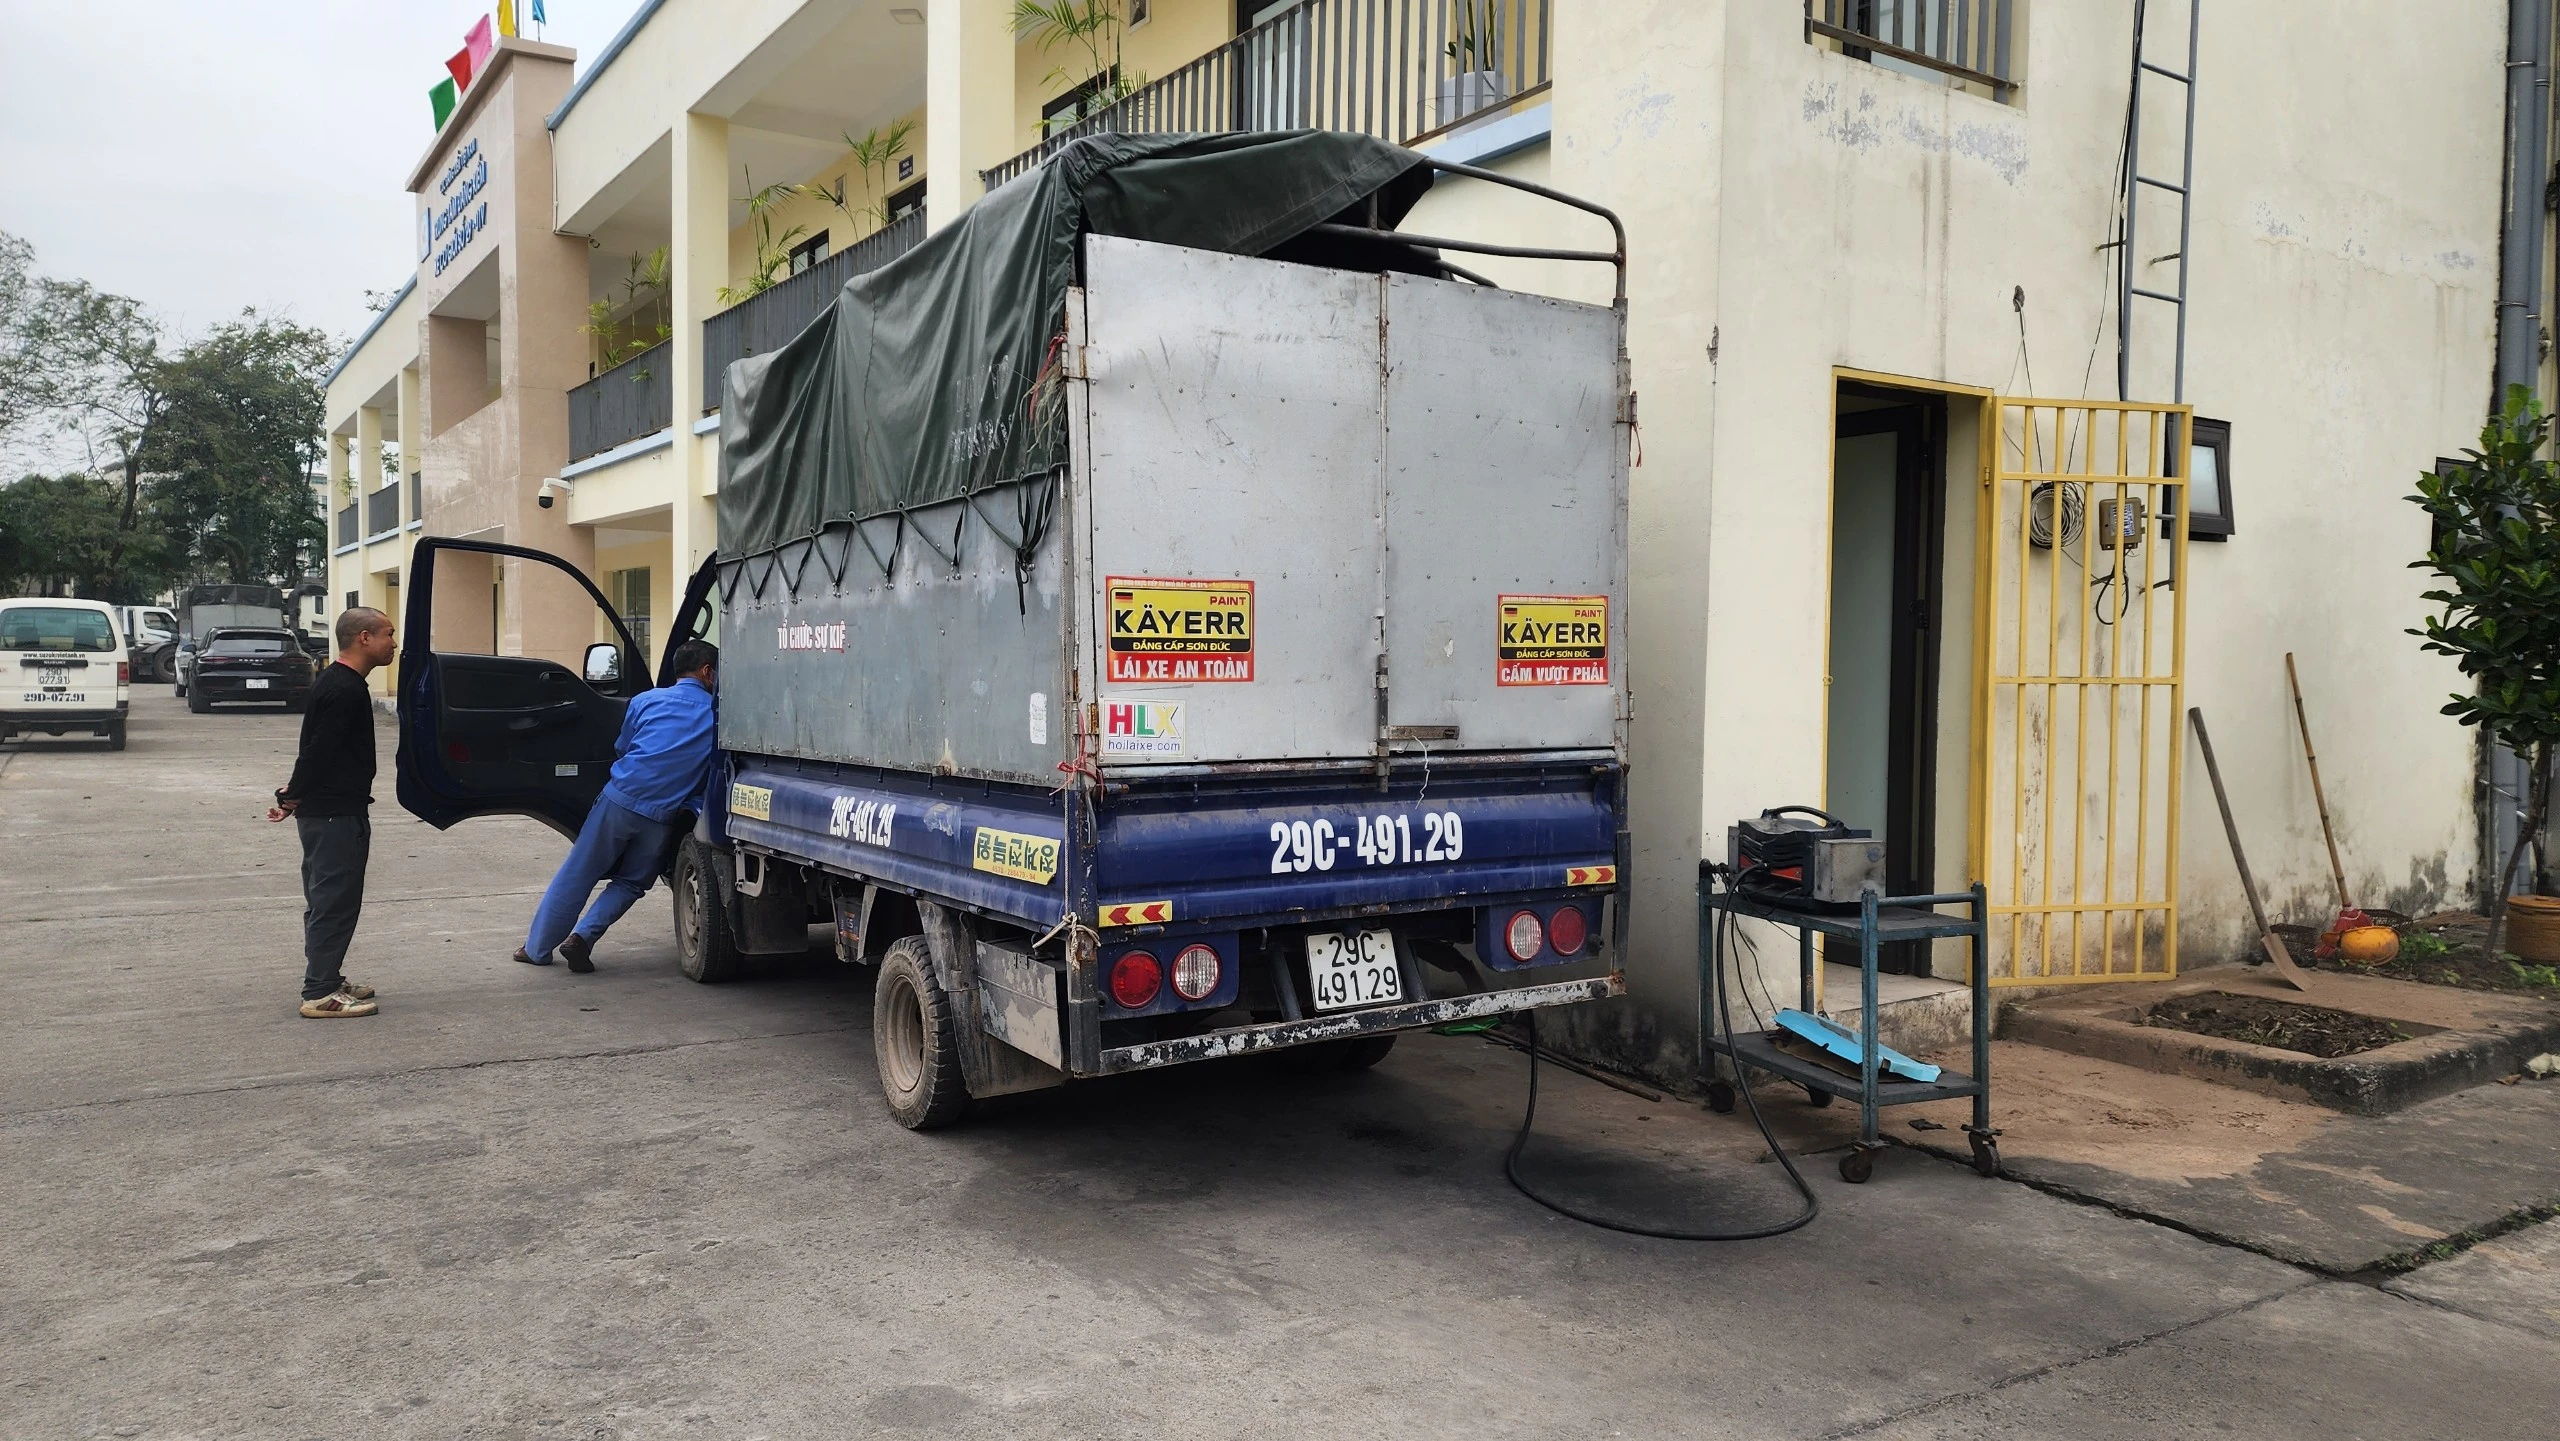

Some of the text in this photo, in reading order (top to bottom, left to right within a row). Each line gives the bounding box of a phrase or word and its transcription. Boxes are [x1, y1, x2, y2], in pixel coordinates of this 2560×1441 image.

[1210, 596, 1246, 605] PAINT
[1115, 604, 1246, 635] KÄYERR
[1574, 609, 1602, 618] PAINT
[789, 619, 813, 649] CHỨC
[814, 622, 829, 653] SỰ
[1503, 617, 1602, 644] KÄYERR
[1164, 640, 1184, 650] CẤP
[1186, 642, 1208, 651] SƠN
[1210, 641, 1231, 651] ĐỨC
[1539, 648, 1555, 658] CẤP
[1556, 650, 1573, 658] SƠN
[45, 668, 62, 676] 29D
[1113, 656, 1248, 678] LÁI XE AN TOÀN
[1501, 662, 1604, 685] CẤM VƯỢT PHẢI
[24, 693, 85, 702] 29D-077.91
[1108, 704, 1181, 738] HLX
[1108, 740, 1180, 751] hoilaixe.com
[829, 795, 897, 848] 29C-491.29
[1270, 811, 1463, 874] 29C-491.29
[1328, 932, 1376, 968] 29C
[1317, 966, 1399, 1005] 491.29
